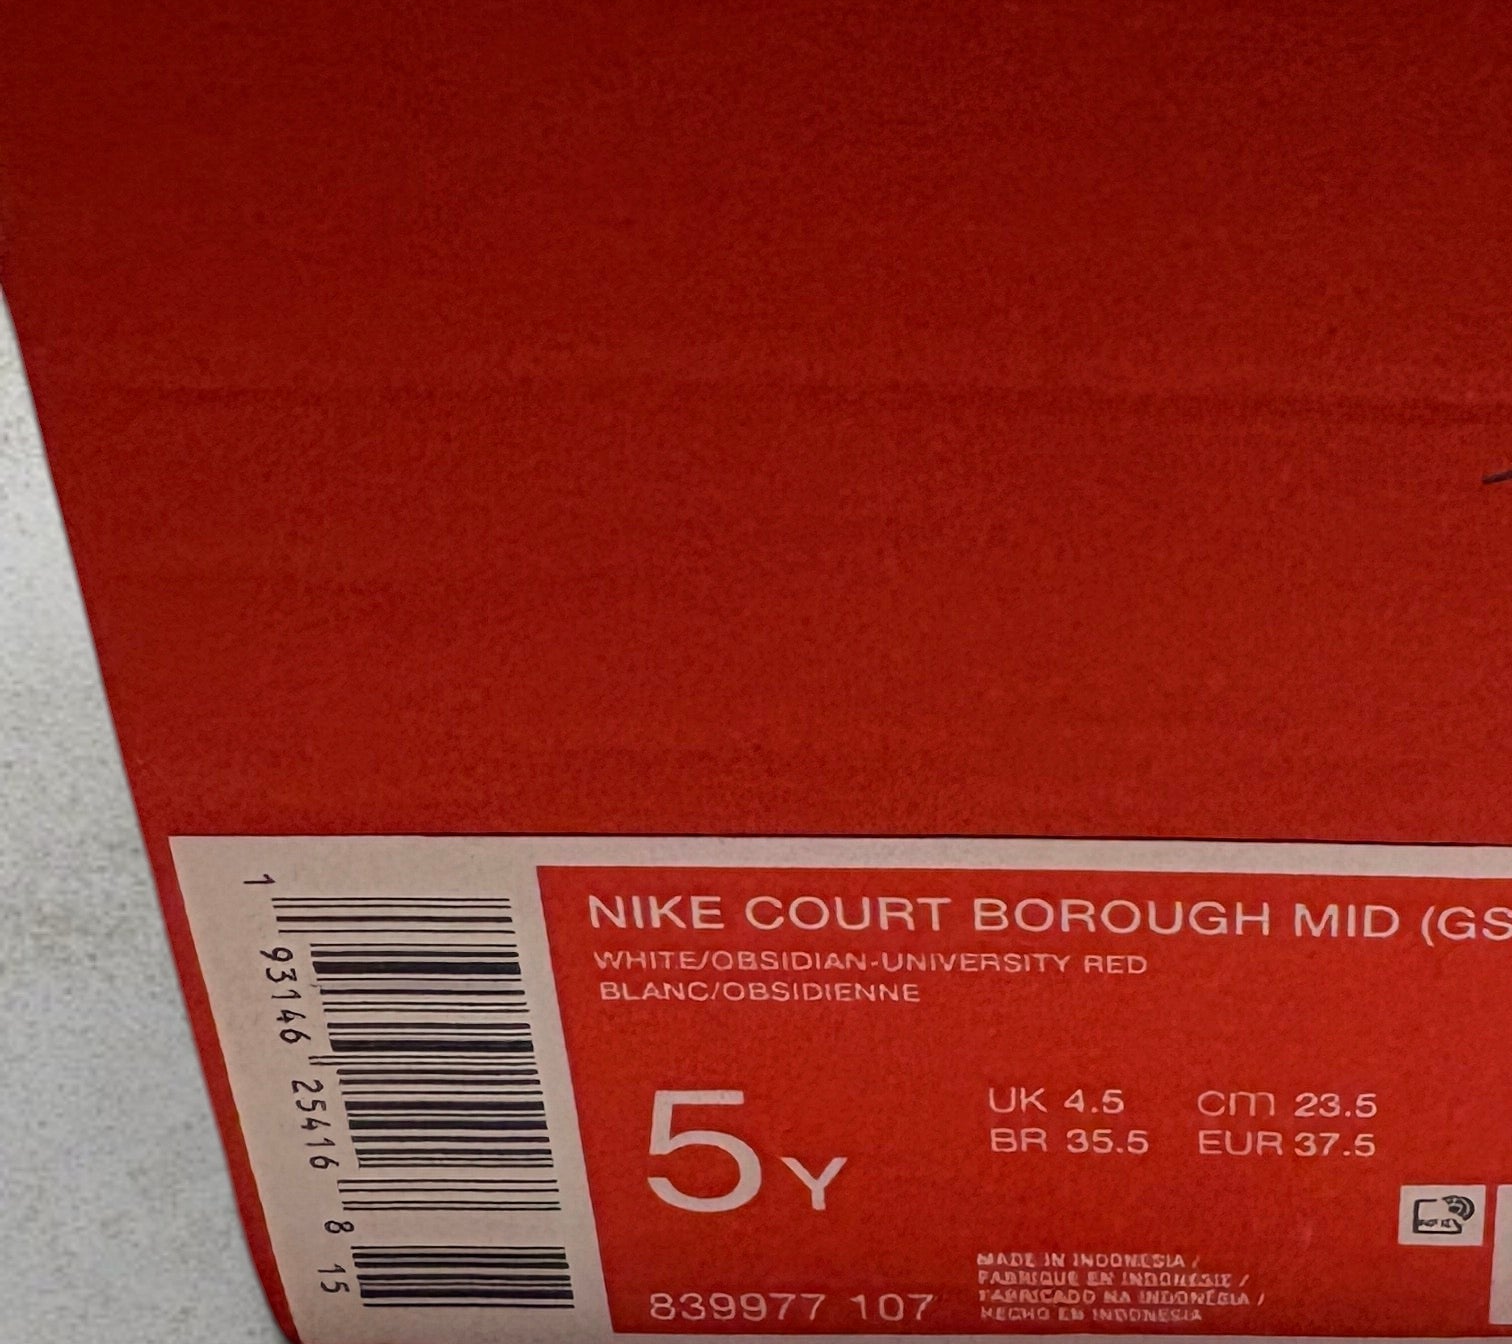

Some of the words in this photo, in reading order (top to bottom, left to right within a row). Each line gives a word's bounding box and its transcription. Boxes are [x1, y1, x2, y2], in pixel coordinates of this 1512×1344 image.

[242, 873, 277, 885] 1
[588, 895, 725, 929] NIKE
[745, 896, 952, 931] COURT
[973, 898, 1270, 936] BOROUGH
[1294, 903, 1400, 939] MID
[593, 950, 1070, 973] WHITE/OBSIDIAN-UNIVERSITY
[1084, 954, 1147, 974] RED
[259, 946, 312, 1045] 93146
[600, 981, 920, 1002] BLANC/OBSIDIENNE
[989, 1087, 1047, 1113] UK
[1064, 1088, 1125, 1114] 4.5
[1294, 1092, 1377, 1118] 23.5
[290, 1079, 341, 1170] 25416
[990, 1127, 1047, 1153] BR
[1066, 1128, 1149, 1154] 35.5
[1198, 1130, 1283, 1156] EUR
[1294, 1132, 1376, 1157] 37.5
[323, 1219, 355, 1235] 8
[976, 1252, 1036, 1268] MADE
[1043, 1252, 1066, 1268] IN
[1072, 1252, 1186, 1268] INDONESIA
[316, 1263, 351, 1294] 15
[650, 1292, 827, 1321] 839977
[850, 1293, 937, 1321] 107
[978, 1288, 1096, 1305] FABRICADO
[980, 1305, 1051, 1322] HECHO
[1092, 1307, 1203, 1323] INDONESIA
